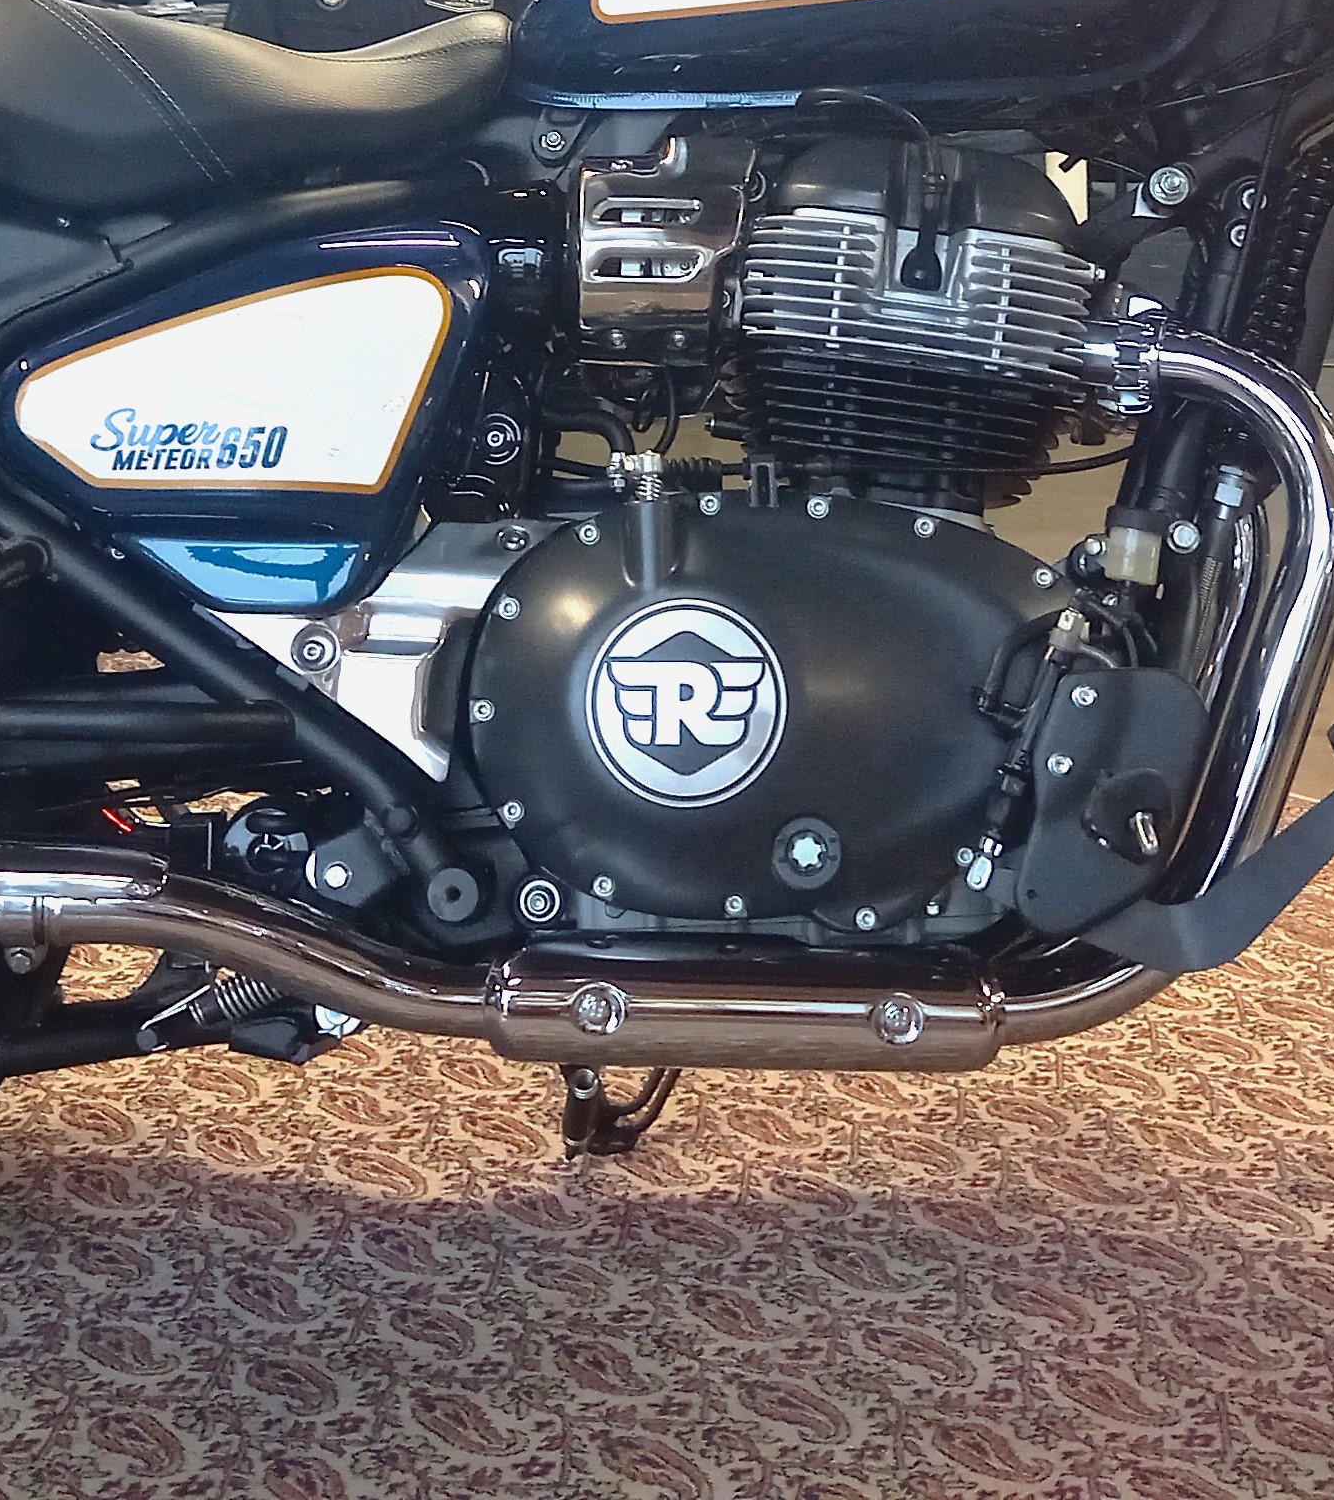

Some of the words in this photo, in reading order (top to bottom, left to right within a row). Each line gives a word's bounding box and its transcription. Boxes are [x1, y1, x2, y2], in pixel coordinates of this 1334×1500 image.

[90, 407, 221, 455] Super
[112, 448, 212, 471] METEOR
[214, 425, 288, 470] 650
